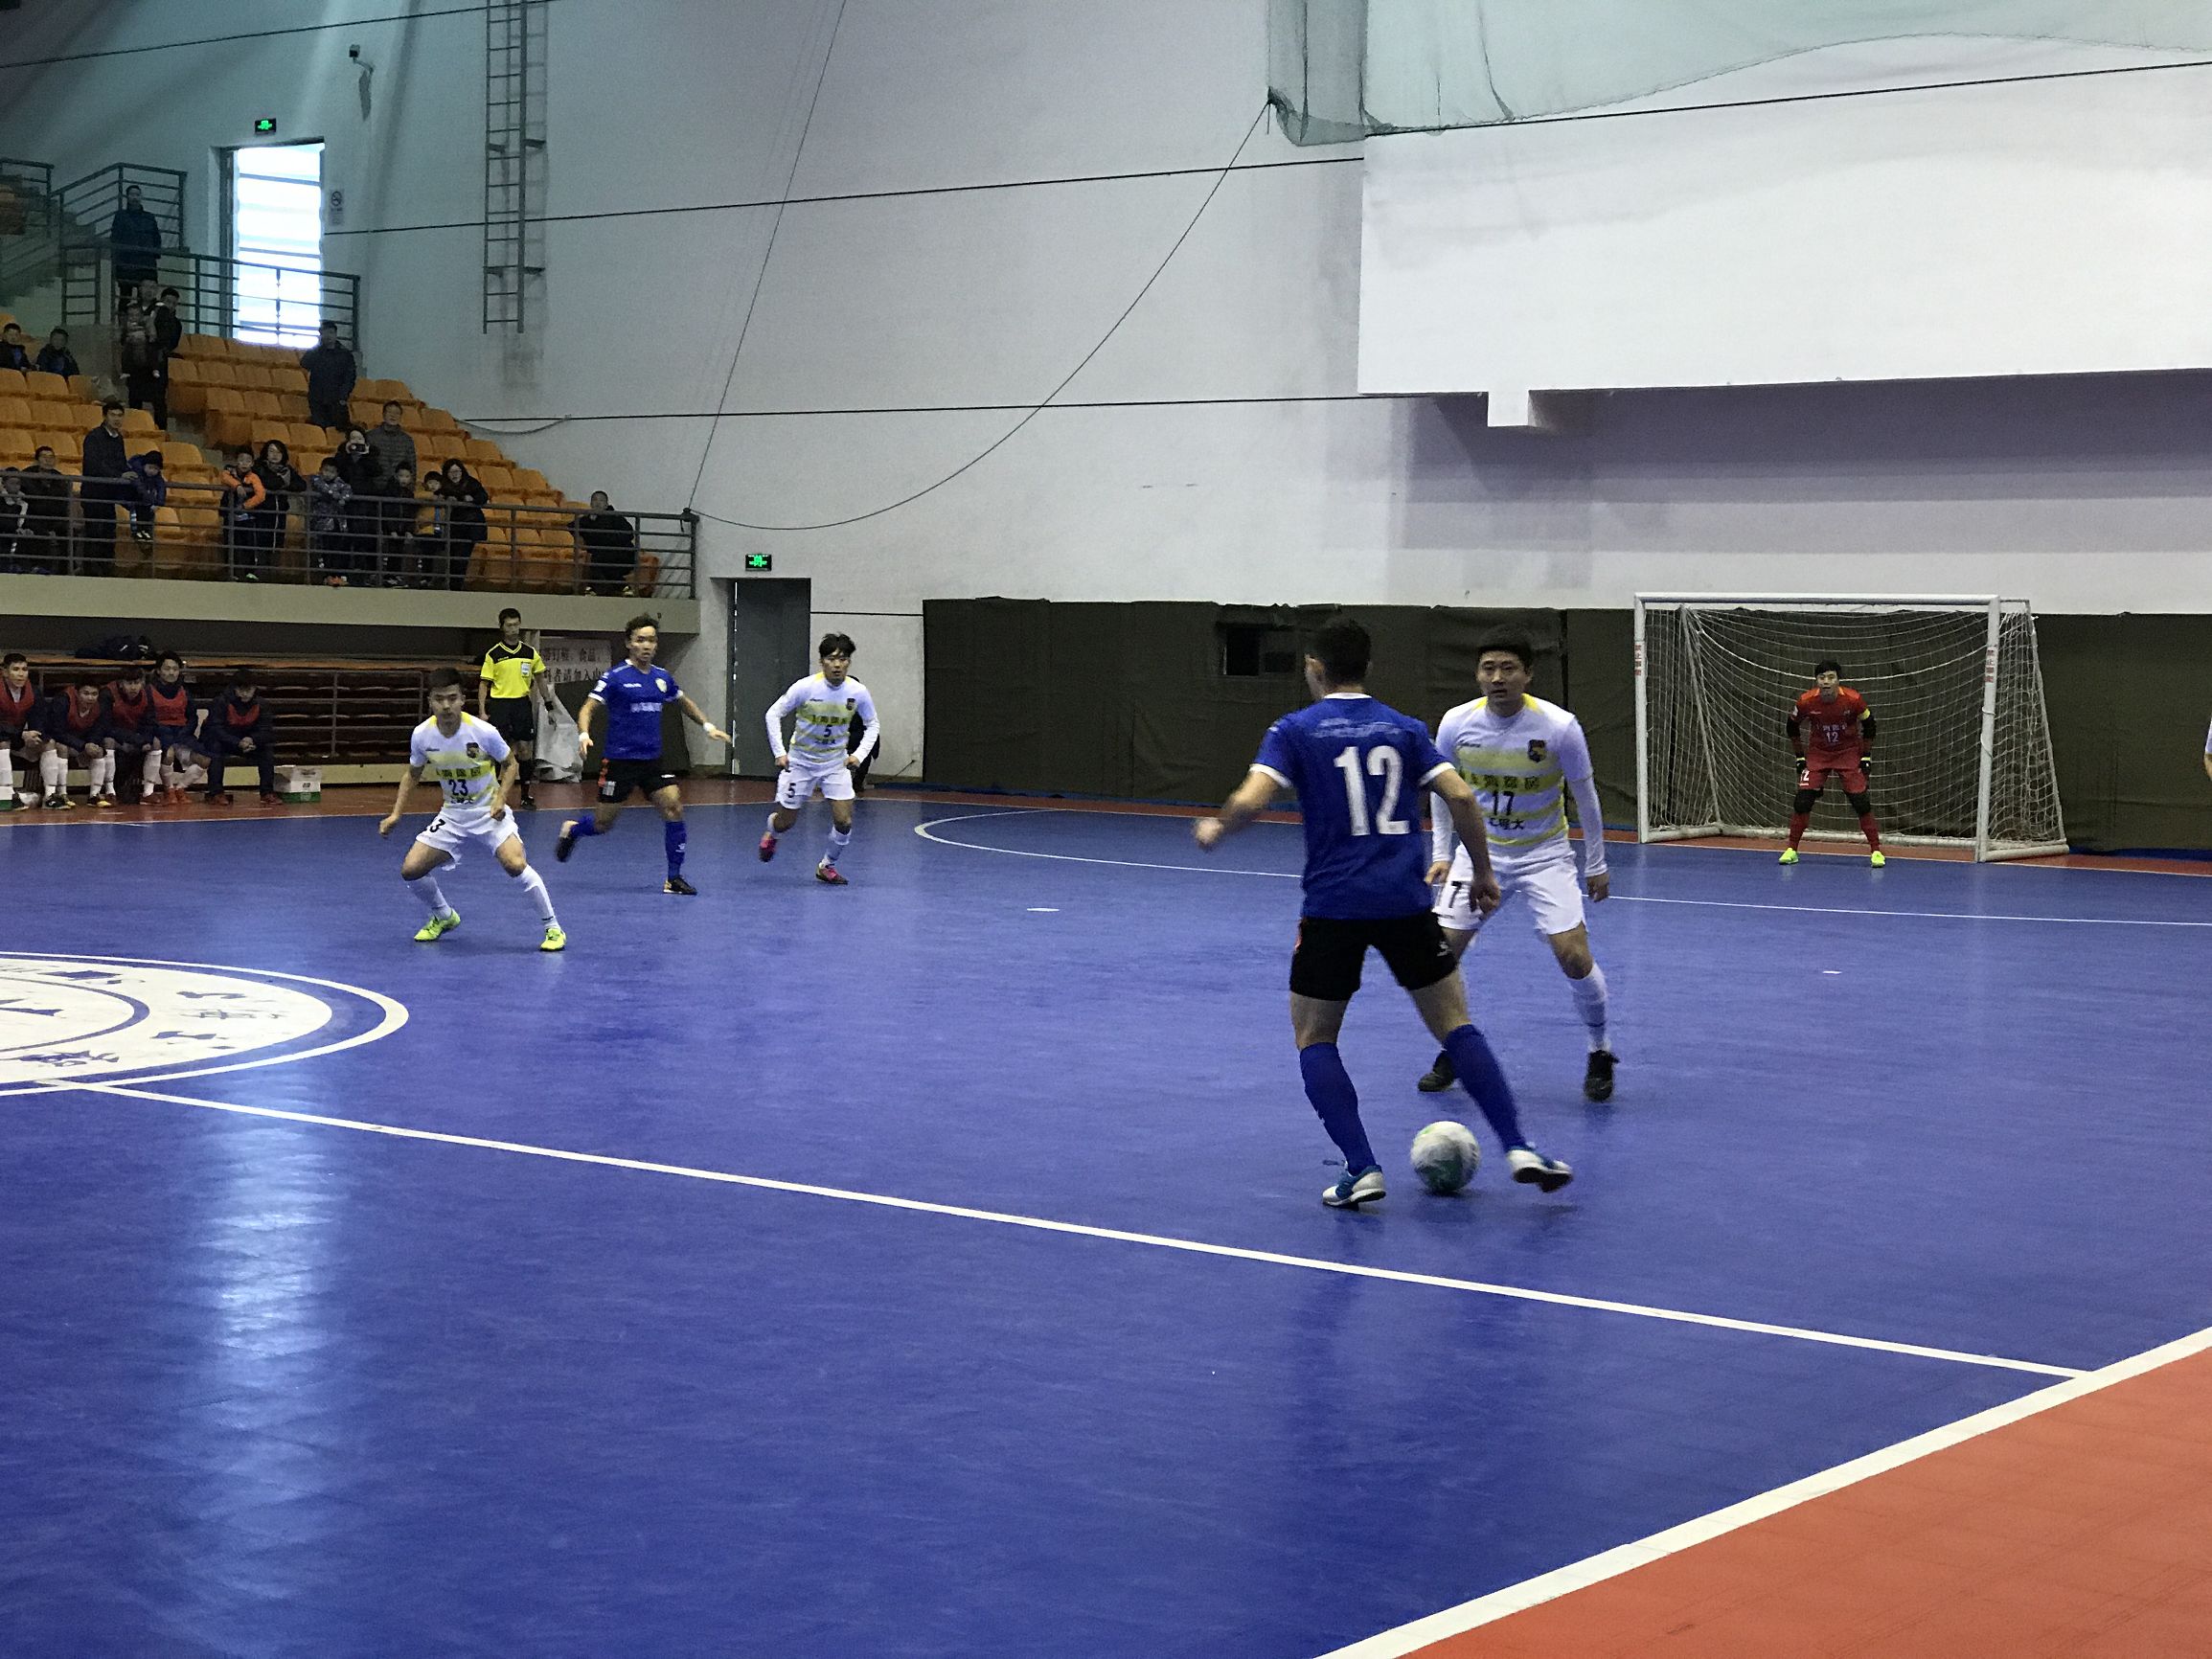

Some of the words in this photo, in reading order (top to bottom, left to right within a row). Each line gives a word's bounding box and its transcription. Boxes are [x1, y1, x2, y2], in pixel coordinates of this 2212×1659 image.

[823, 724, 832, 738] 5
[1826, 732, 1839, 742] 12
[448, 779, 468, 796] 23
[787, 783, 796, 798] 5
[1333, 744, 1411, 836] 12
[1491, 790, 1515, 815] 17
